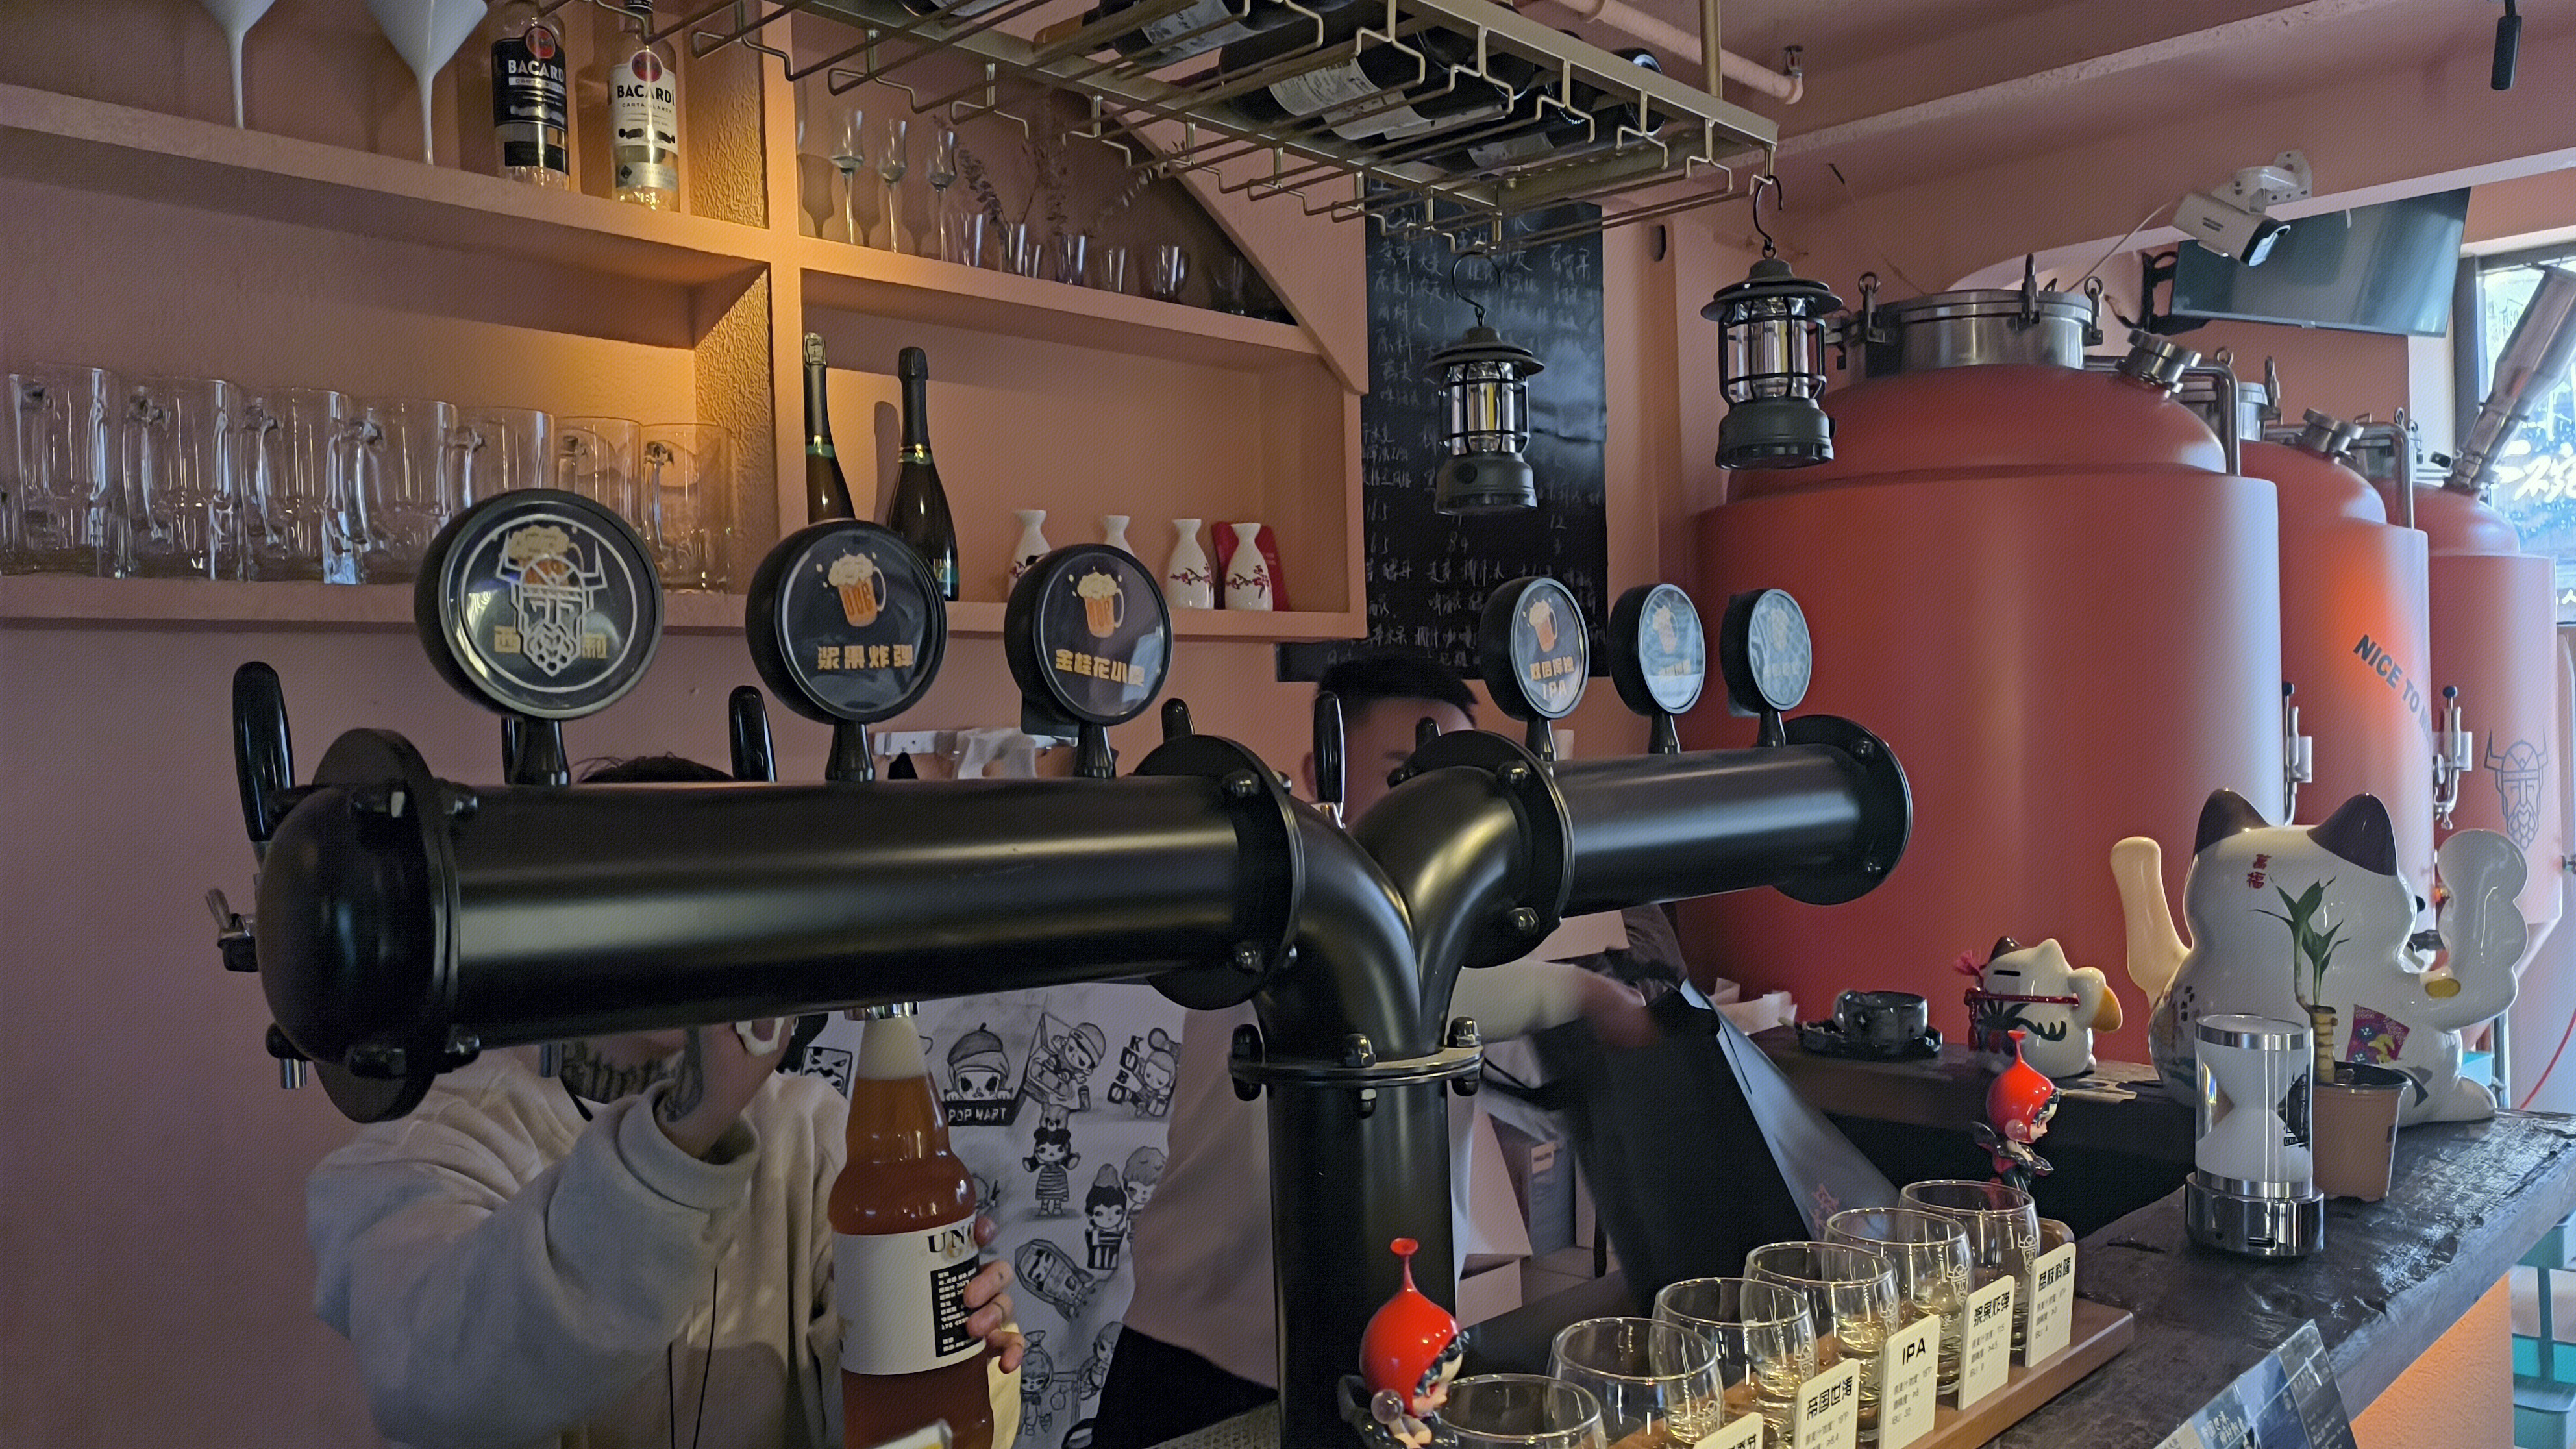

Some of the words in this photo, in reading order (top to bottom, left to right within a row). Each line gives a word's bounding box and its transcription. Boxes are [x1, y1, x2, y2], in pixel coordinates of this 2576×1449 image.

[508, 60, 565, 83] BACARD
[650, 104, 673, 114] LANCA
[2353, 634, 2403, 689] NICE
[2403, 677, 2420, 713] TO
[1542, 679, 1567, 700] IPA
[948, 1108, 972, 1122] POP
[1902, 1337, 1926, 1366] IPA
